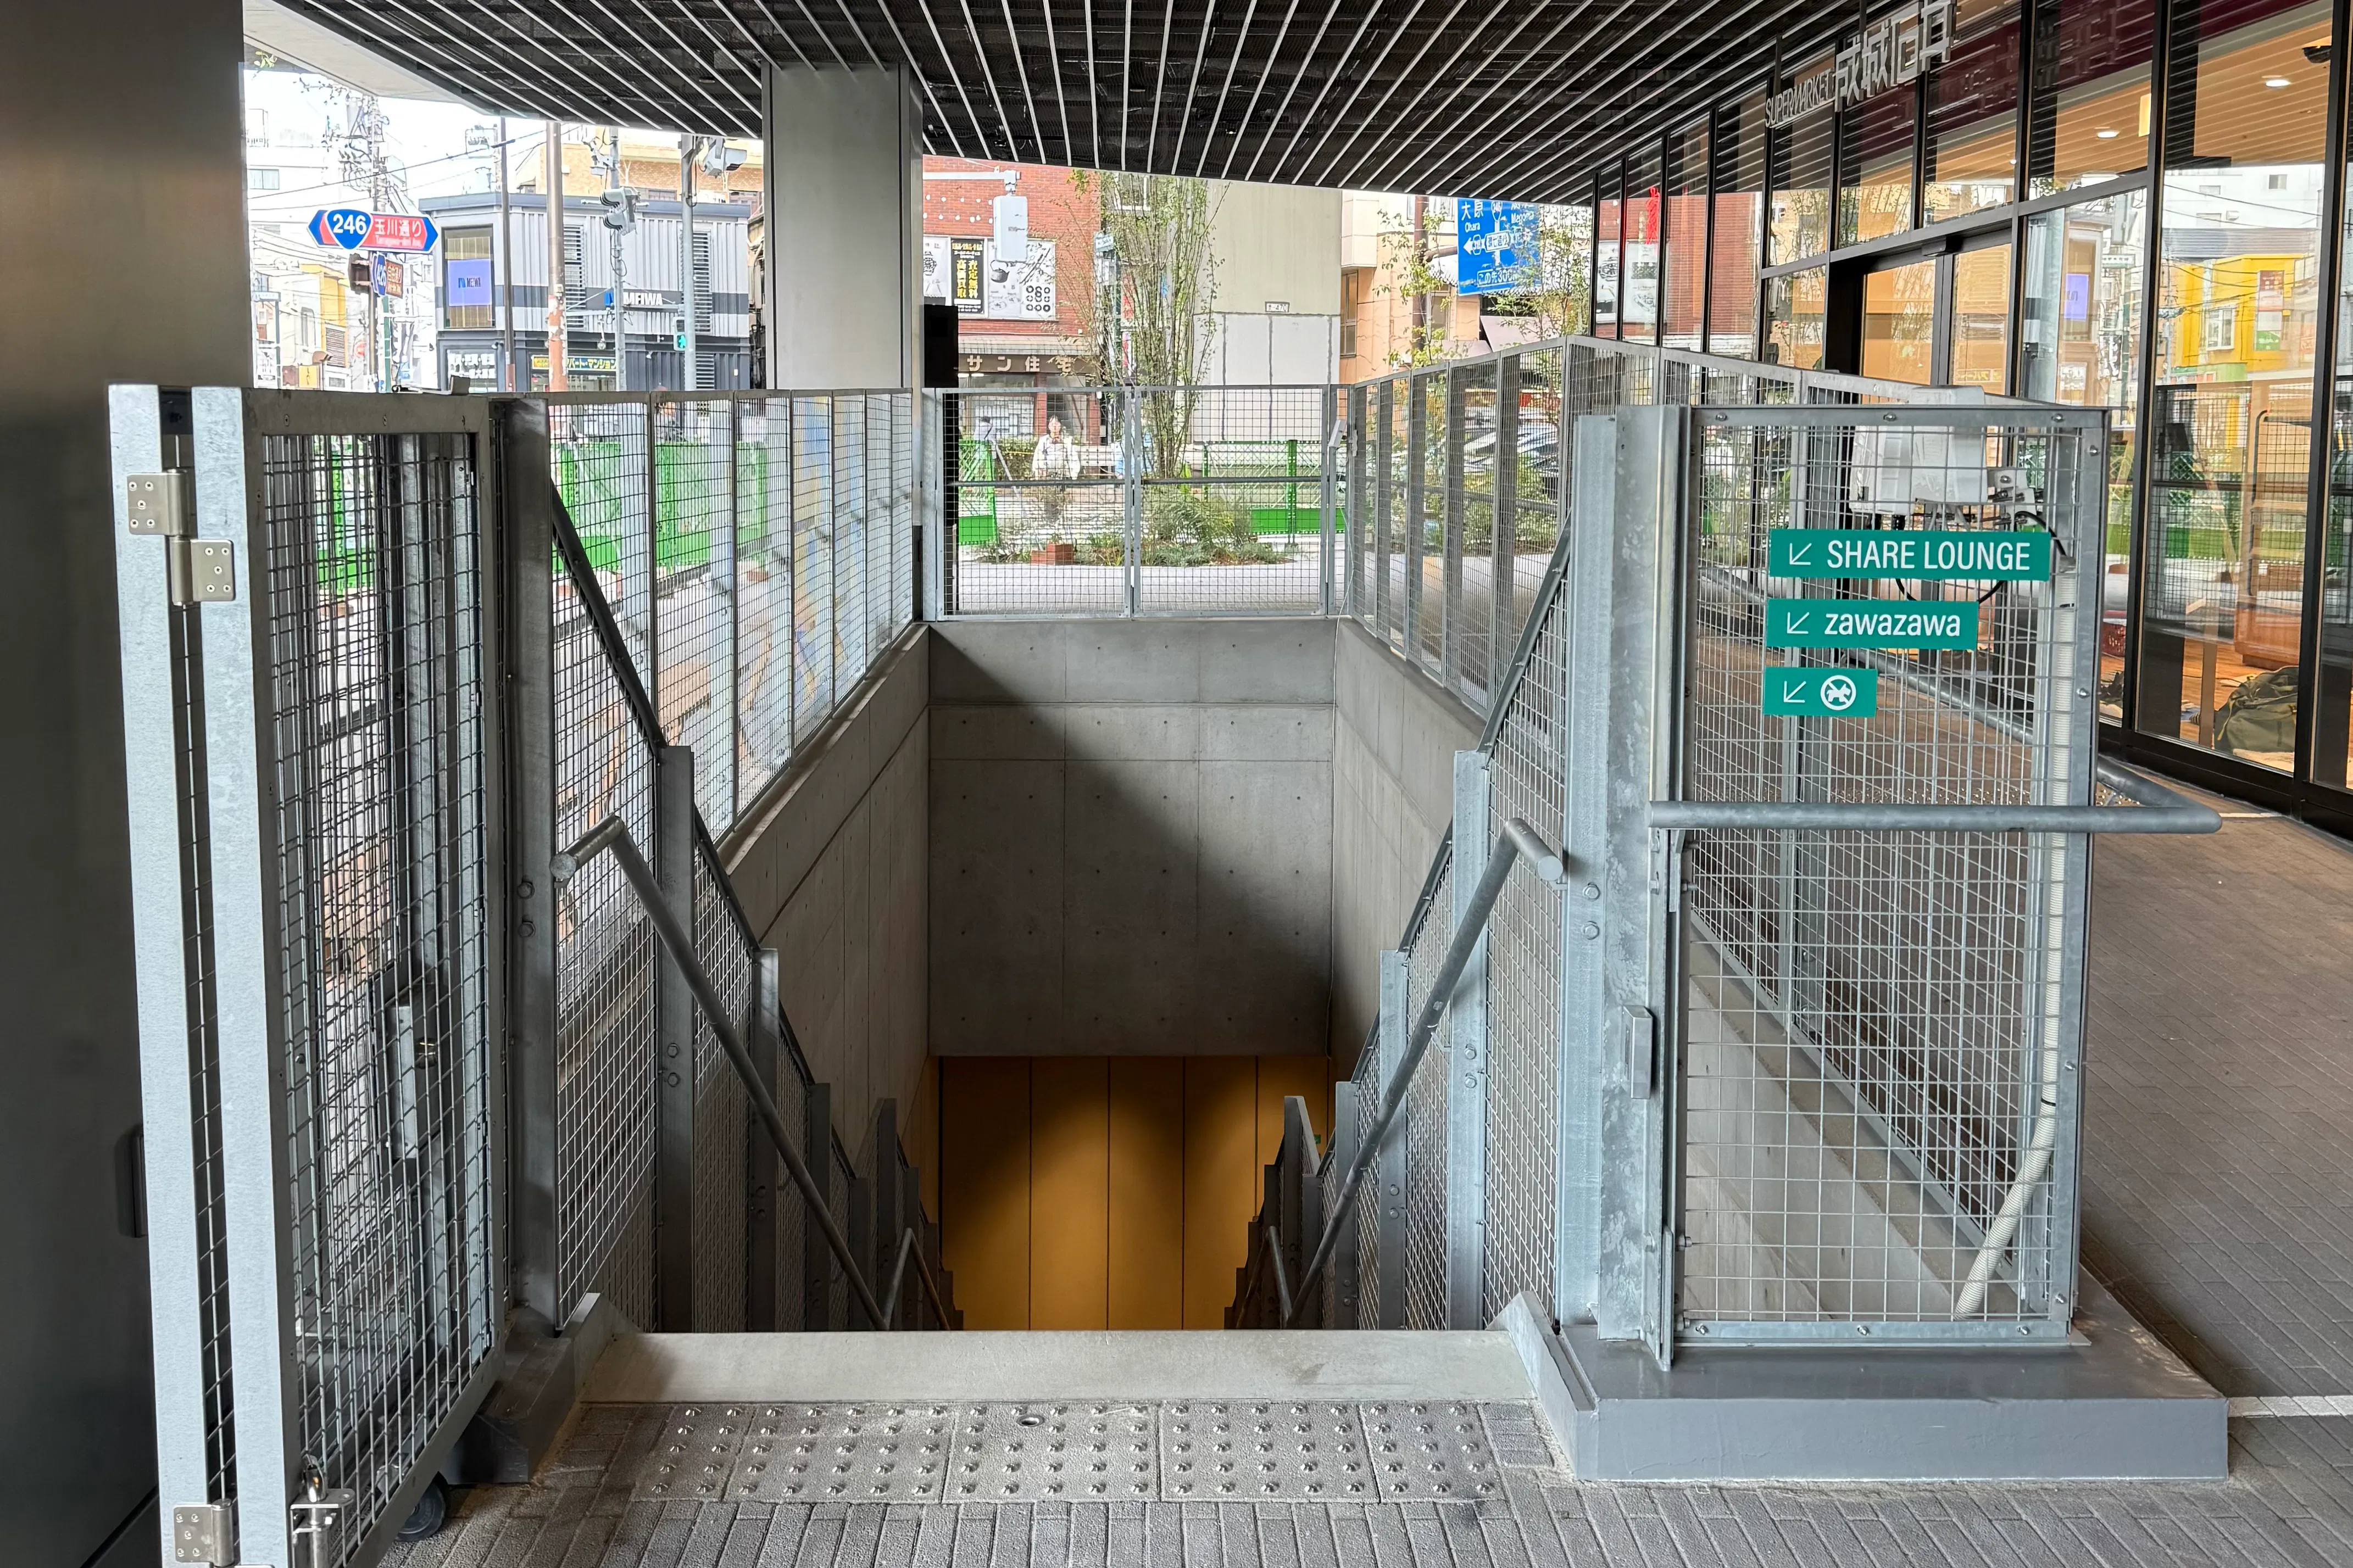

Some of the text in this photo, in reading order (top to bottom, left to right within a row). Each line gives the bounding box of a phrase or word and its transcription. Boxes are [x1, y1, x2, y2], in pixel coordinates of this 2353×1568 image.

[1765, 68, 1835, 127] SUPERMARKET
[1461, 200, 1484, 221] 大原
[332, 213, 367, 235] 246
[375, 218, 422, 237] 玉川通り
[1465, 222, 1481, 233] Ohara
[1827, 539, 2031, 571] SHARE LOUNGE
[1824, 612, 1961, 637] zawazawa
